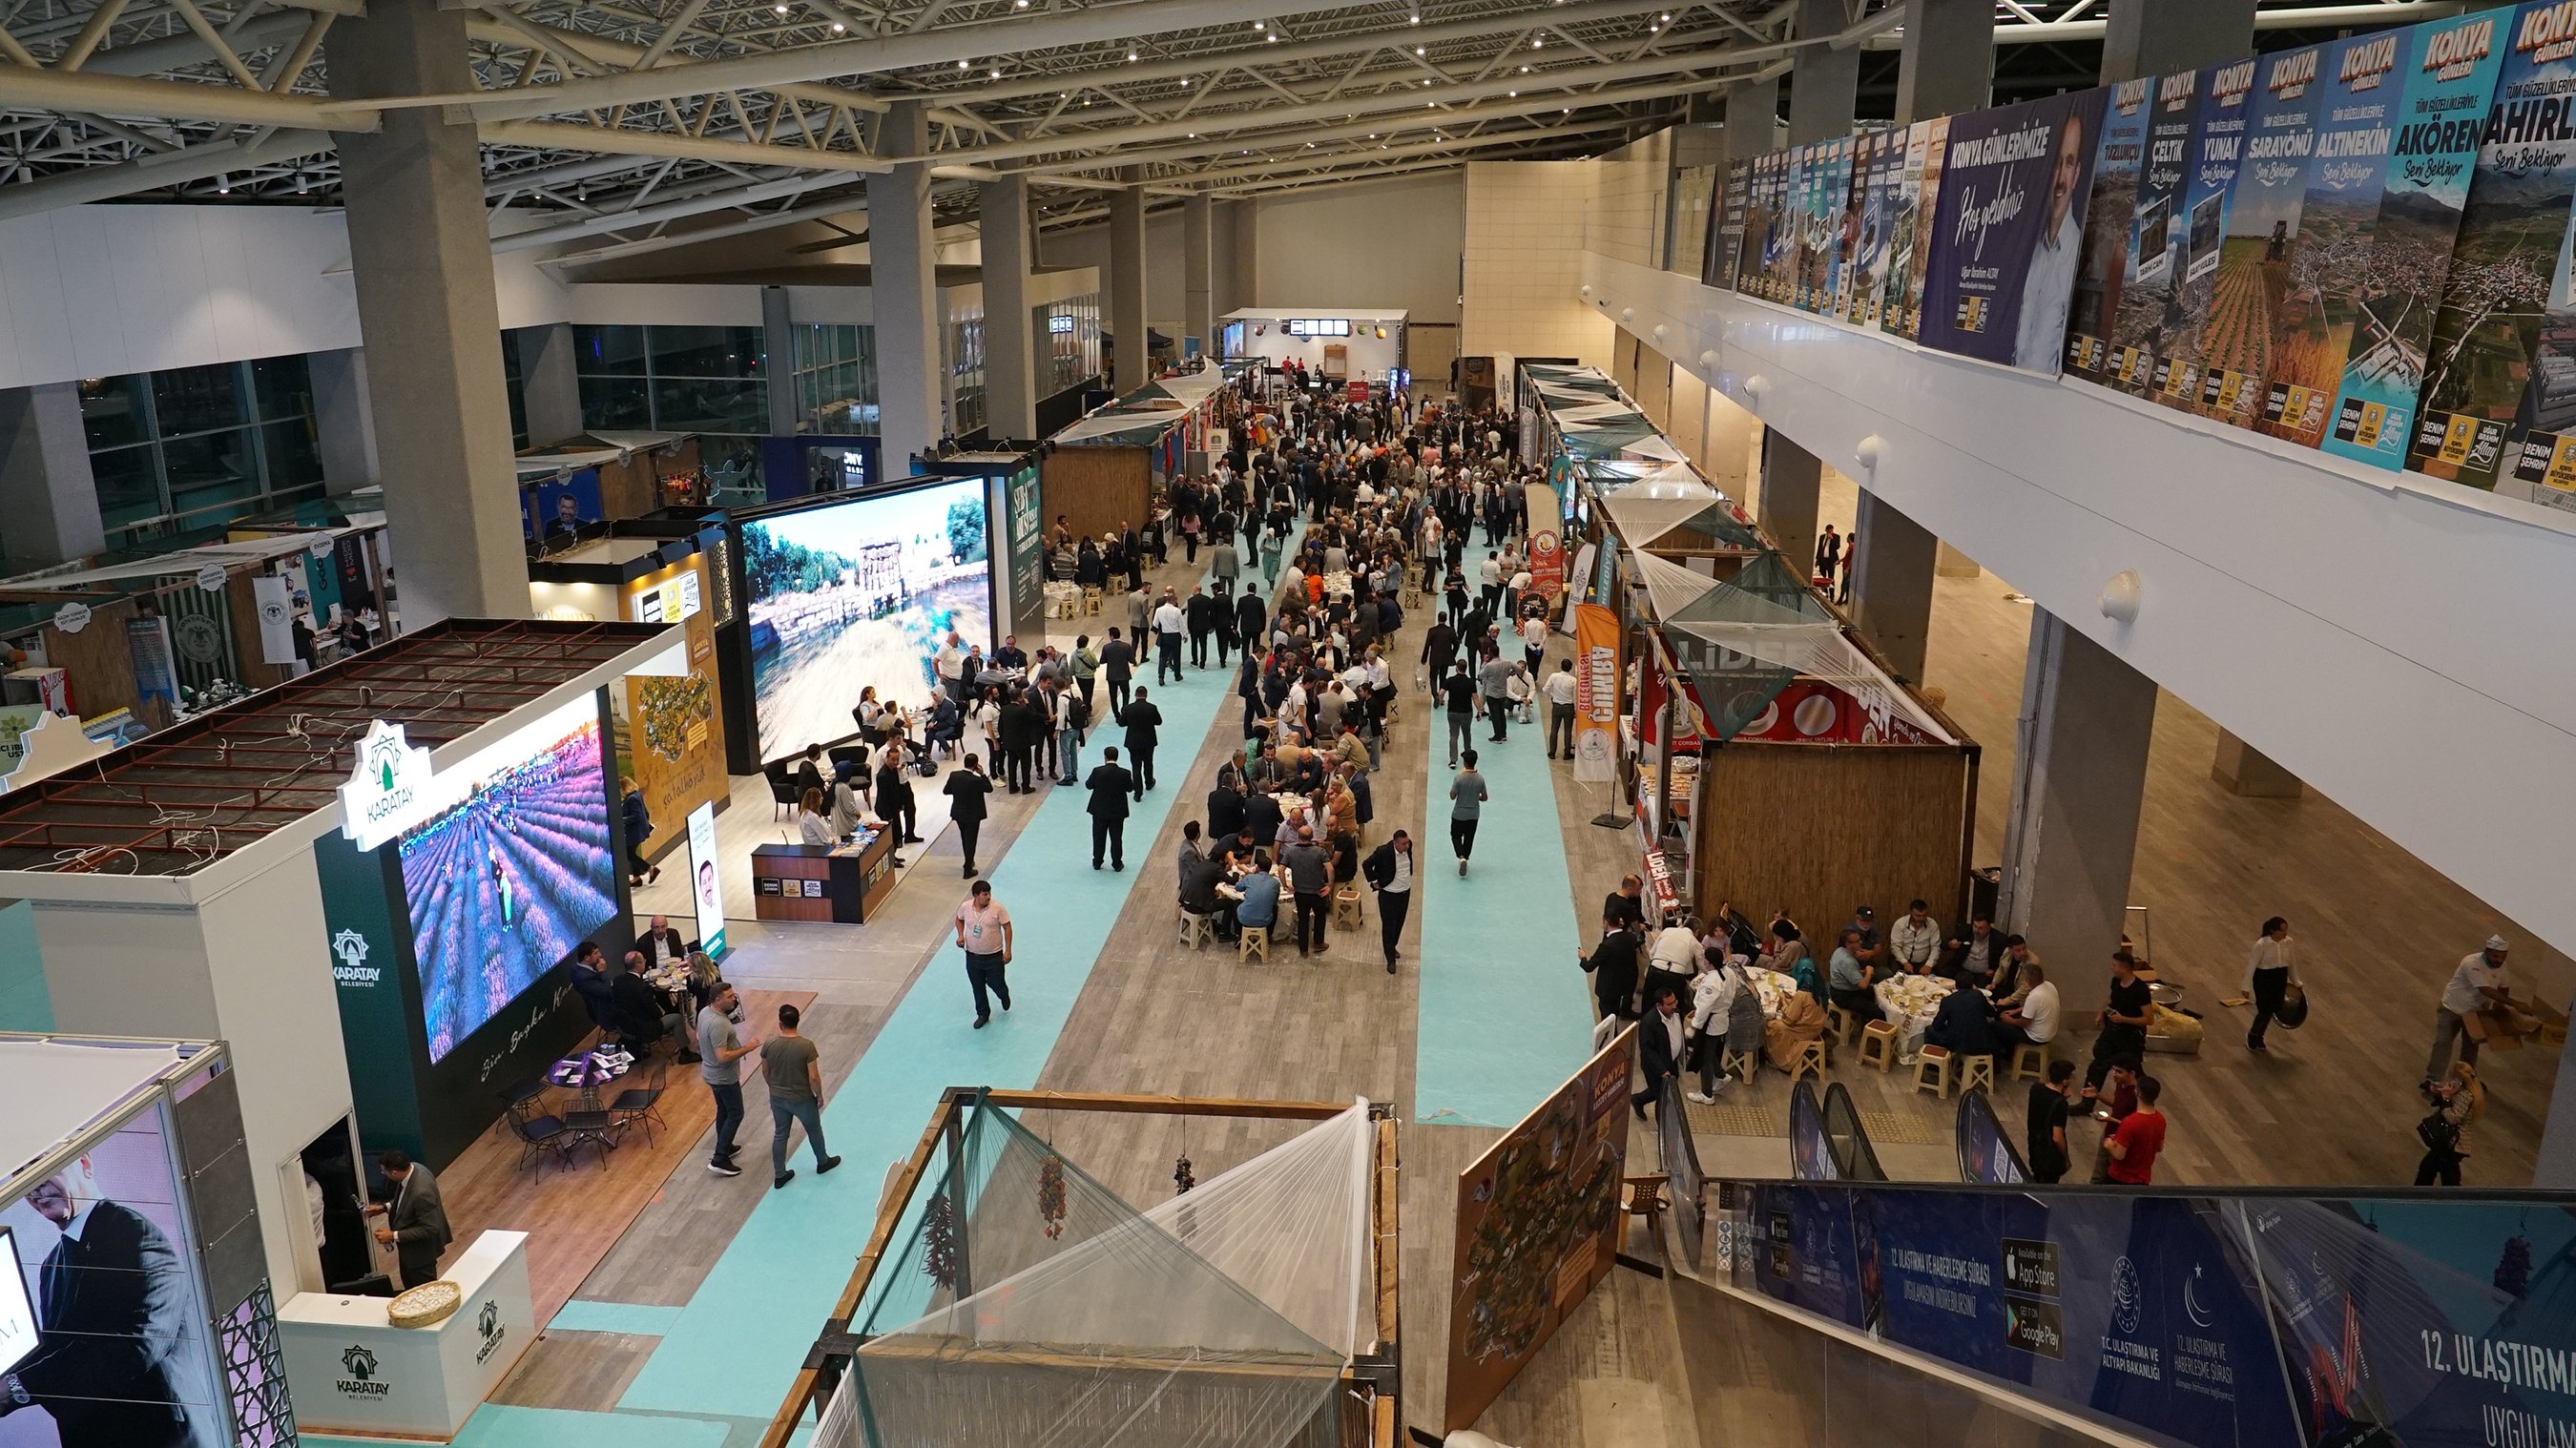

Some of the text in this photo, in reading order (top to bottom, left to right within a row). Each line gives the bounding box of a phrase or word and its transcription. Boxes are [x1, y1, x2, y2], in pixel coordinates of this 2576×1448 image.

[2516, 1, 2576, 51] KONY
[2338, 36, 2398, 83] KONYA
[2422, 18, 2495, 72] KONYA
[2533, 37, 2575, 65] GÜNLERİ
[2212, 61, 2255, 97] KONYA
[2269, 50, 2318, 93] KONYA
[2351, 70, 2382, 93] GÜNLERİ
[2437, 57, 2474, 82] GÜNLERİ
[2115, 77, 2146, 111] KONYA
[2160, 70, 2196, 103] KONYA
[2278, 81, 2304, 102] GÜNLERİ
[2505, 81, 2521, 99] TÜM
[2416, 98, 2428, 114] TÜM
[2483, 96, 2576, 145] AHIRL
[1950, 118, 2050, 169] KONYA GÜNLERİMİZE
[2204, 136, 2241, 161] YUNAK
[2248, 129, 2313, 159] SARAYÖNÜ
[2315, 121, 2391, 157] ALTINEKİN
[2394, 114, 2485, 155] AKÖREN
[2105, 144, 2141, 165] TUZLUKÇU
[2152, 139, 2185, 168] ÇELTİK
[2494, 147, 2566, 176] Seni Bekliyor
[2322, 161, 2374, 187] Seni Bekliyor
[2403, 158, 2462, 185] Seni Bekliyor
[1954, 185, 1981, 247] Hoş
[1974, 163, 2025, 262] geldiniz
[2341, 407, 2361, 421] BENİM
[2422, 421, 2446, 435] BENİM
[2420, 433, 2442, 446] ŞEHRİM
[2471, 440, 2498, 460] Altay
[2524, 443, 2552, 458] BENİM
[2520, 456, 2547, 471] ŞEHRİM
[366, 784, 414, 824] KARATAY
[1646, 851, 1670, 880] LİDER
[481, 1050, 504, 1083] Bir
[509, 1006, 548, 1054] Başka
[1594, 1062, 1625, 1100] KONYA
[1924, 1253, 1933, 1274] VE
[2018, 1248, 2037, 1260] Available
[2019, 1263, 2055, 1288] App Store
[2028, 1307, 2032, 1316] IT
[2032, 1308, 2038, 1318] ON
[475, 1322, 506, 1366] KARATAY
[2020, 1319, 2060, 1352] Google Play
[2101, 1336, 2159, 1362] T.C. ULAŞTIRMA VE
[2177, 1334, 2227, 1361] 12. ULAŞTIRMA VE
[2330, 1345, 2345, 1386] mobilite
[2421, 1329, 2451, 1373] 12.
[2102, 1355, 2160, 1381] ALTYAPI BAKANLIĞI
[2174, 1355, 2233, 1384] HABERLEŞME ŞÛRASI
[336, 1379, 390, 1396] KARATAY
[2305, 1366, 2318, 1402] lojistik
